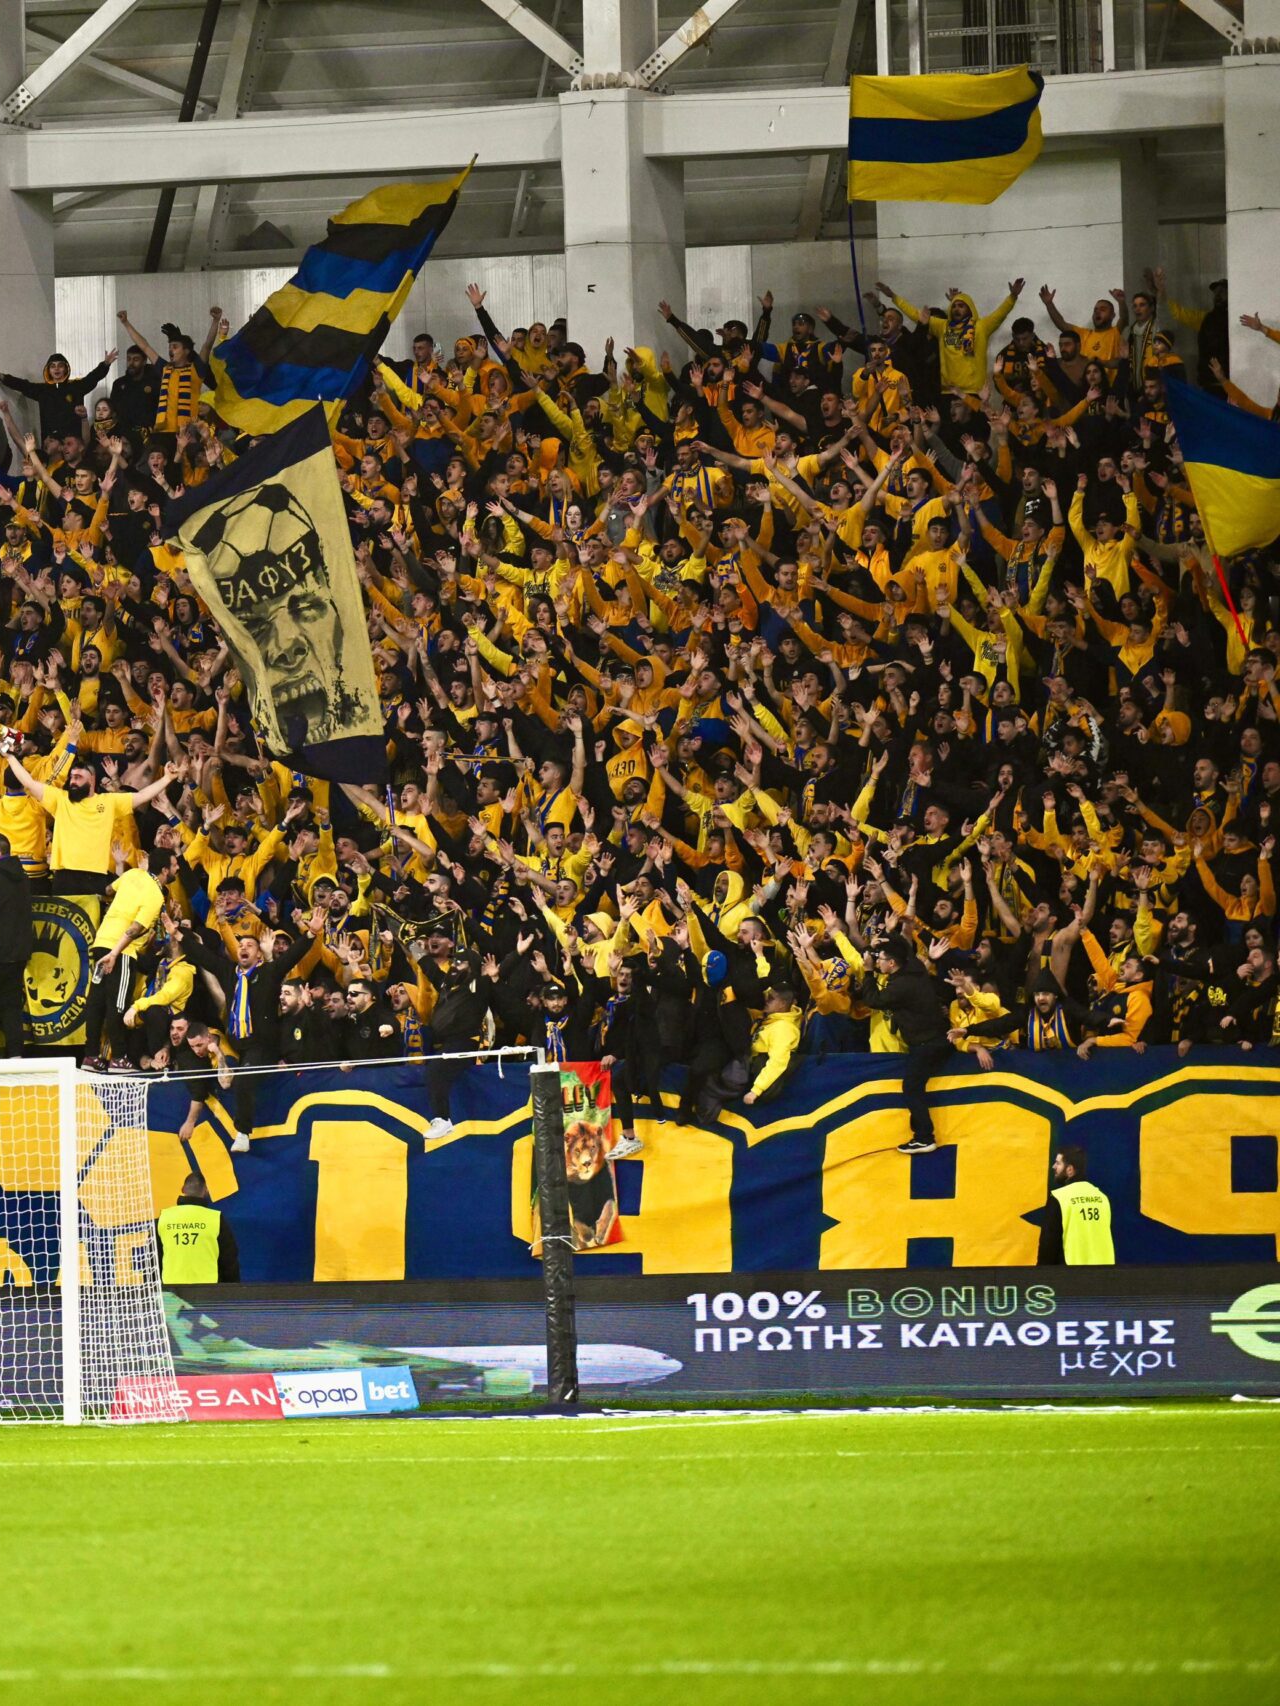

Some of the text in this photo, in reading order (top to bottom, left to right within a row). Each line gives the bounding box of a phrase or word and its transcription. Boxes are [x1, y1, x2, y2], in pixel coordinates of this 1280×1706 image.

[32, 903, 70, 918] RIBE
[1080, 1207, 1100, 1220] 158
[166, 1222, 207, 1230] STEWARD
[173, 1232, 199, 1245] 137
[686, 1285, 1057, 1322] 100% BONUS
[694, 1319, 1176, 1352] ΠΡΩΤΗΣ ΚΑΤΑΘΕΣΗΣ
[1060, 1346, 1177, 1377] μέχρι
[126, 1387, 281, 1409] NISSAN
[298, 1381, 410, 1409] opap bet
